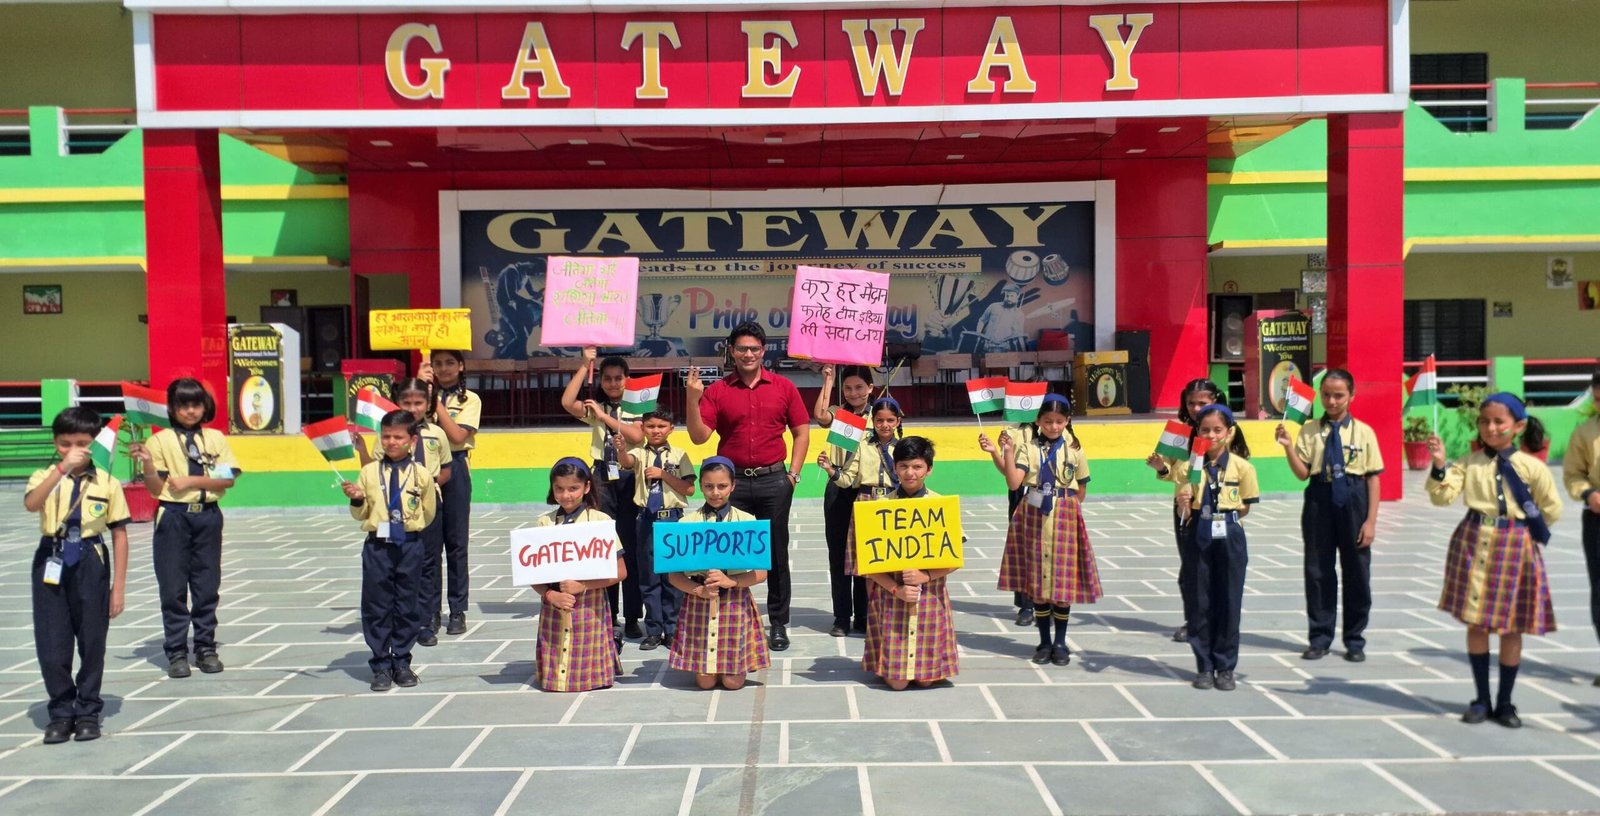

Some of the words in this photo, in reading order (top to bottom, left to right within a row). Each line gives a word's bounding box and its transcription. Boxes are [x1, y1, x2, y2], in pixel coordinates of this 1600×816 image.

[384, 13, 1154, 101] GATEWAY
[486, 204, 1067, 254] GATEWAY
[639, 263, 687, 273] eads
[695, 263, 716, 272] to
[725, 262, 760, 272] the
[866, 260, 888, 270] of
[892, 260, 966, 270] success
[801, 279, 833, 303] कर
[836, 282, 860, 304] हर
[682, 287, 760, 330] Pride
[835, 306, 858, 322] टीम
[800, 322, 818, 337] तेरी
[825, 325, 854, 342] सदा
[855, 328, 883, 344] जय
[1261, 320, 1308, 336] GATEWAY
[232, 336, 278, 350] GATEWAY
[1263, 343, 1307, 352] Welcomes
[234, 358, 278, 367] Welcomes
[1278, 352, 1293, 360] You
[248, 367, 264, 376] You
[875, 507, 946, 531] TEAM
[518, 536, 614, 568] GATEWAY
[662, 529, 768, 559] SUPPORTS
[865, 531, 960, 565] INDIA
